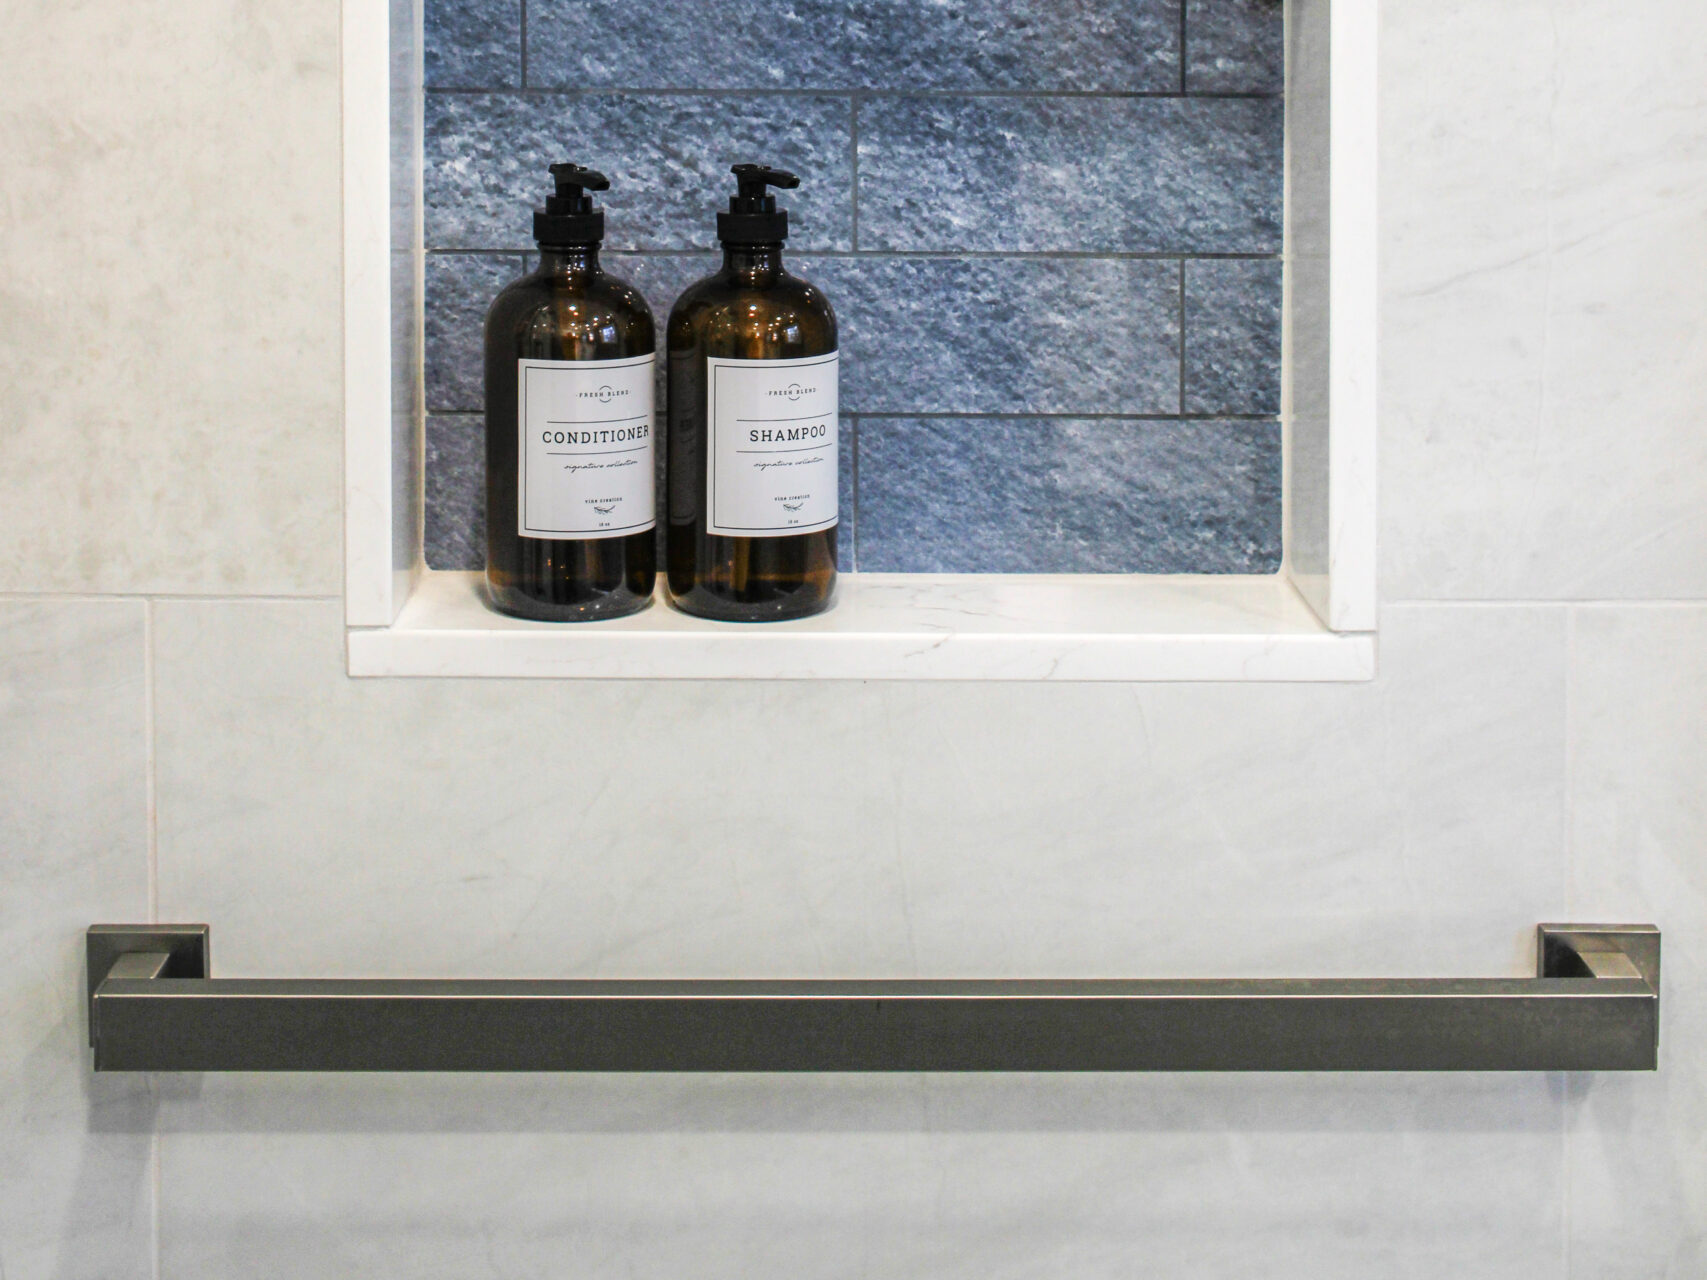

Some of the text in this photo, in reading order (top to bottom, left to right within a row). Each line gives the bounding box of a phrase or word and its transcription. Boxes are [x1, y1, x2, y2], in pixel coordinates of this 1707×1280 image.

[542, 424, 649, 444] CONDITIONER
[749, 424, 826, 442] SHAMPOO
[564, 460, 639, 474] signature collection
[753, 457, 825, 472] signature collection
